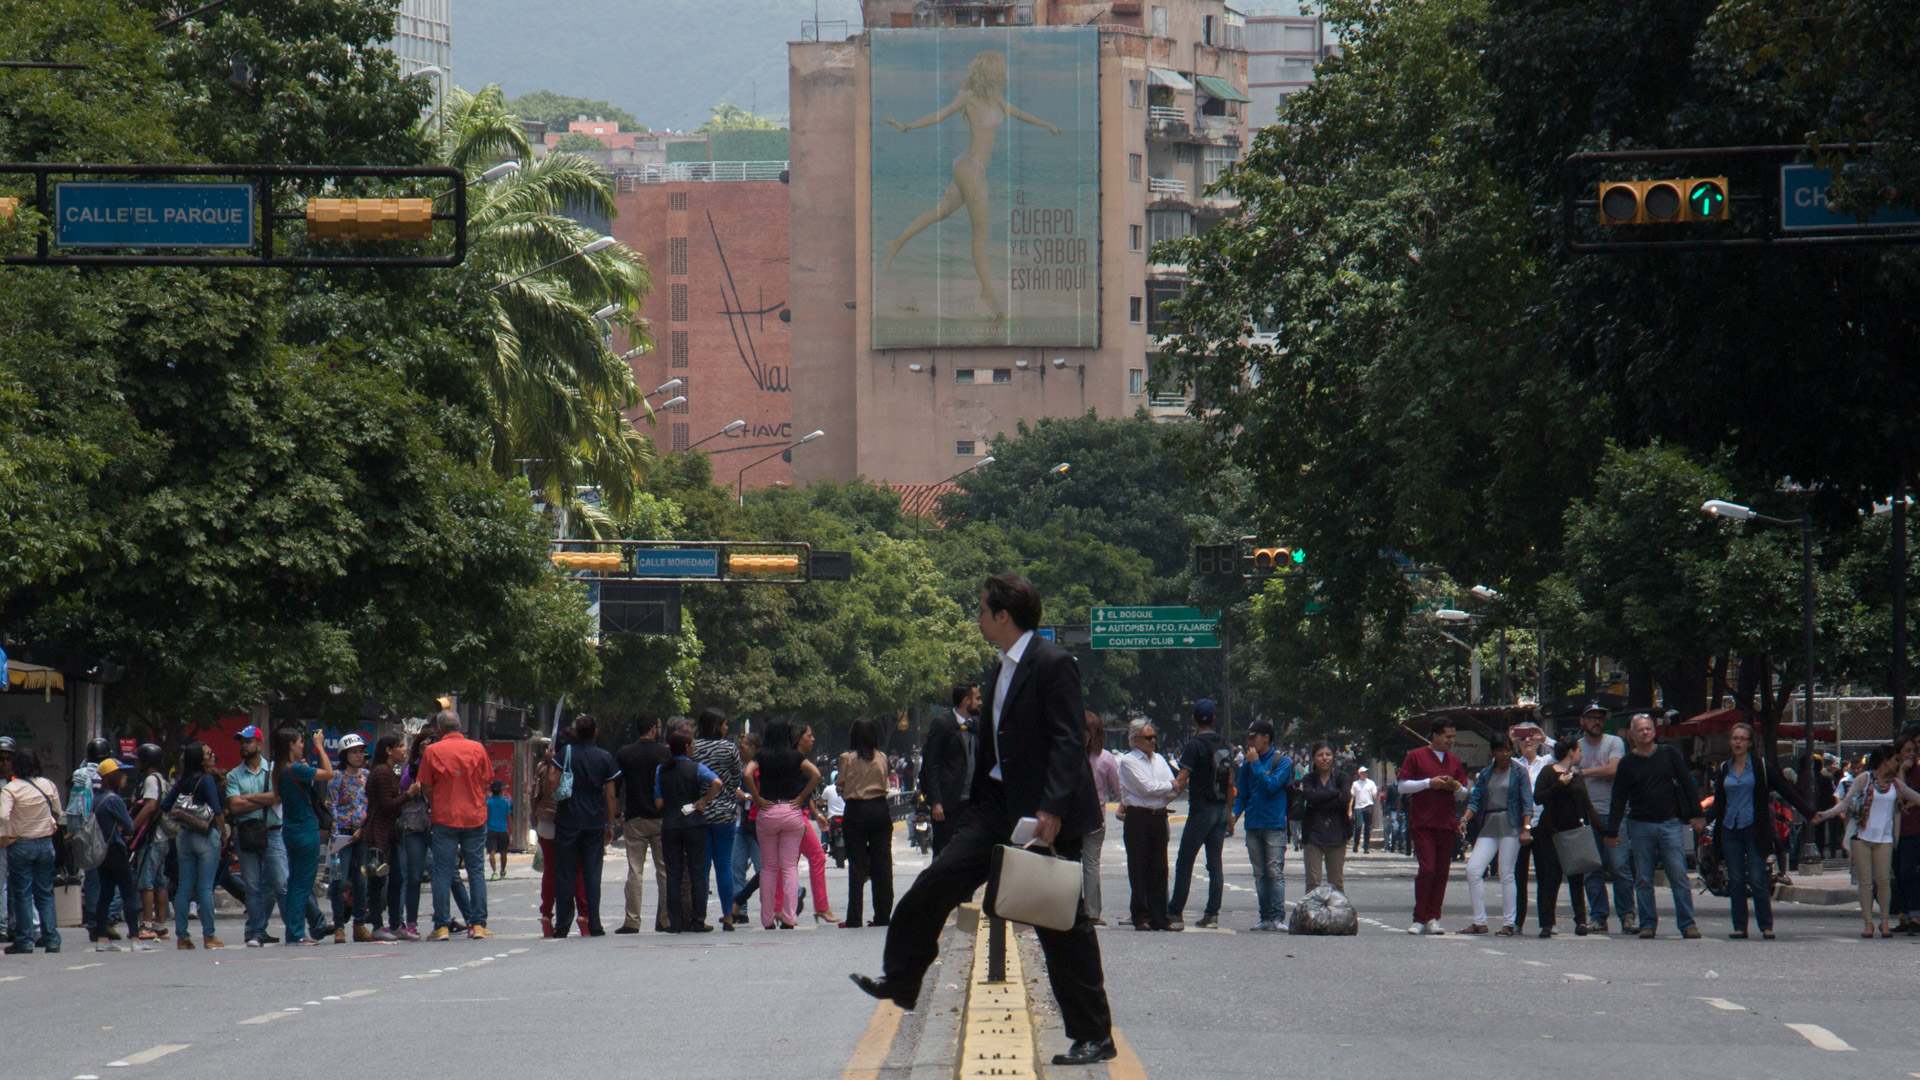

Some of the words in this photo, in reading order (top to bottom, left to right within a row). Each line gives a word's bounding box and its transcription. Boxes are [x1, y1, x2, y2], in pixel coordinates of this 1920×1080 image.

[1016, 189, 1026, 205] EL
[66, 207, 129, 223] CALLE
[135, 208, 158, 223] EL
[163, 208, 243, 224] PARQUE
[1011, 208, 1074, 235] CUERPO
[1011, 240, 1017, 256] Y
[1020, 240, 1030, 256] EL
[1033, 238, 1087, 264] SABOR
[1011, 265, 1051, 290] ESTÁN
[640, 558, 666, 567] CALLE
[667, 558, 715, 567] MOHEDANO
[1107, 611, 1118, 619] EL
[1119, 611, 1153, 619] BOSQUE
[1156, 624, 1177, 632] FCO.
[1109, 638, 1150, 646] COUNTRY
[1151, 637, 1174, 645] CLUB
